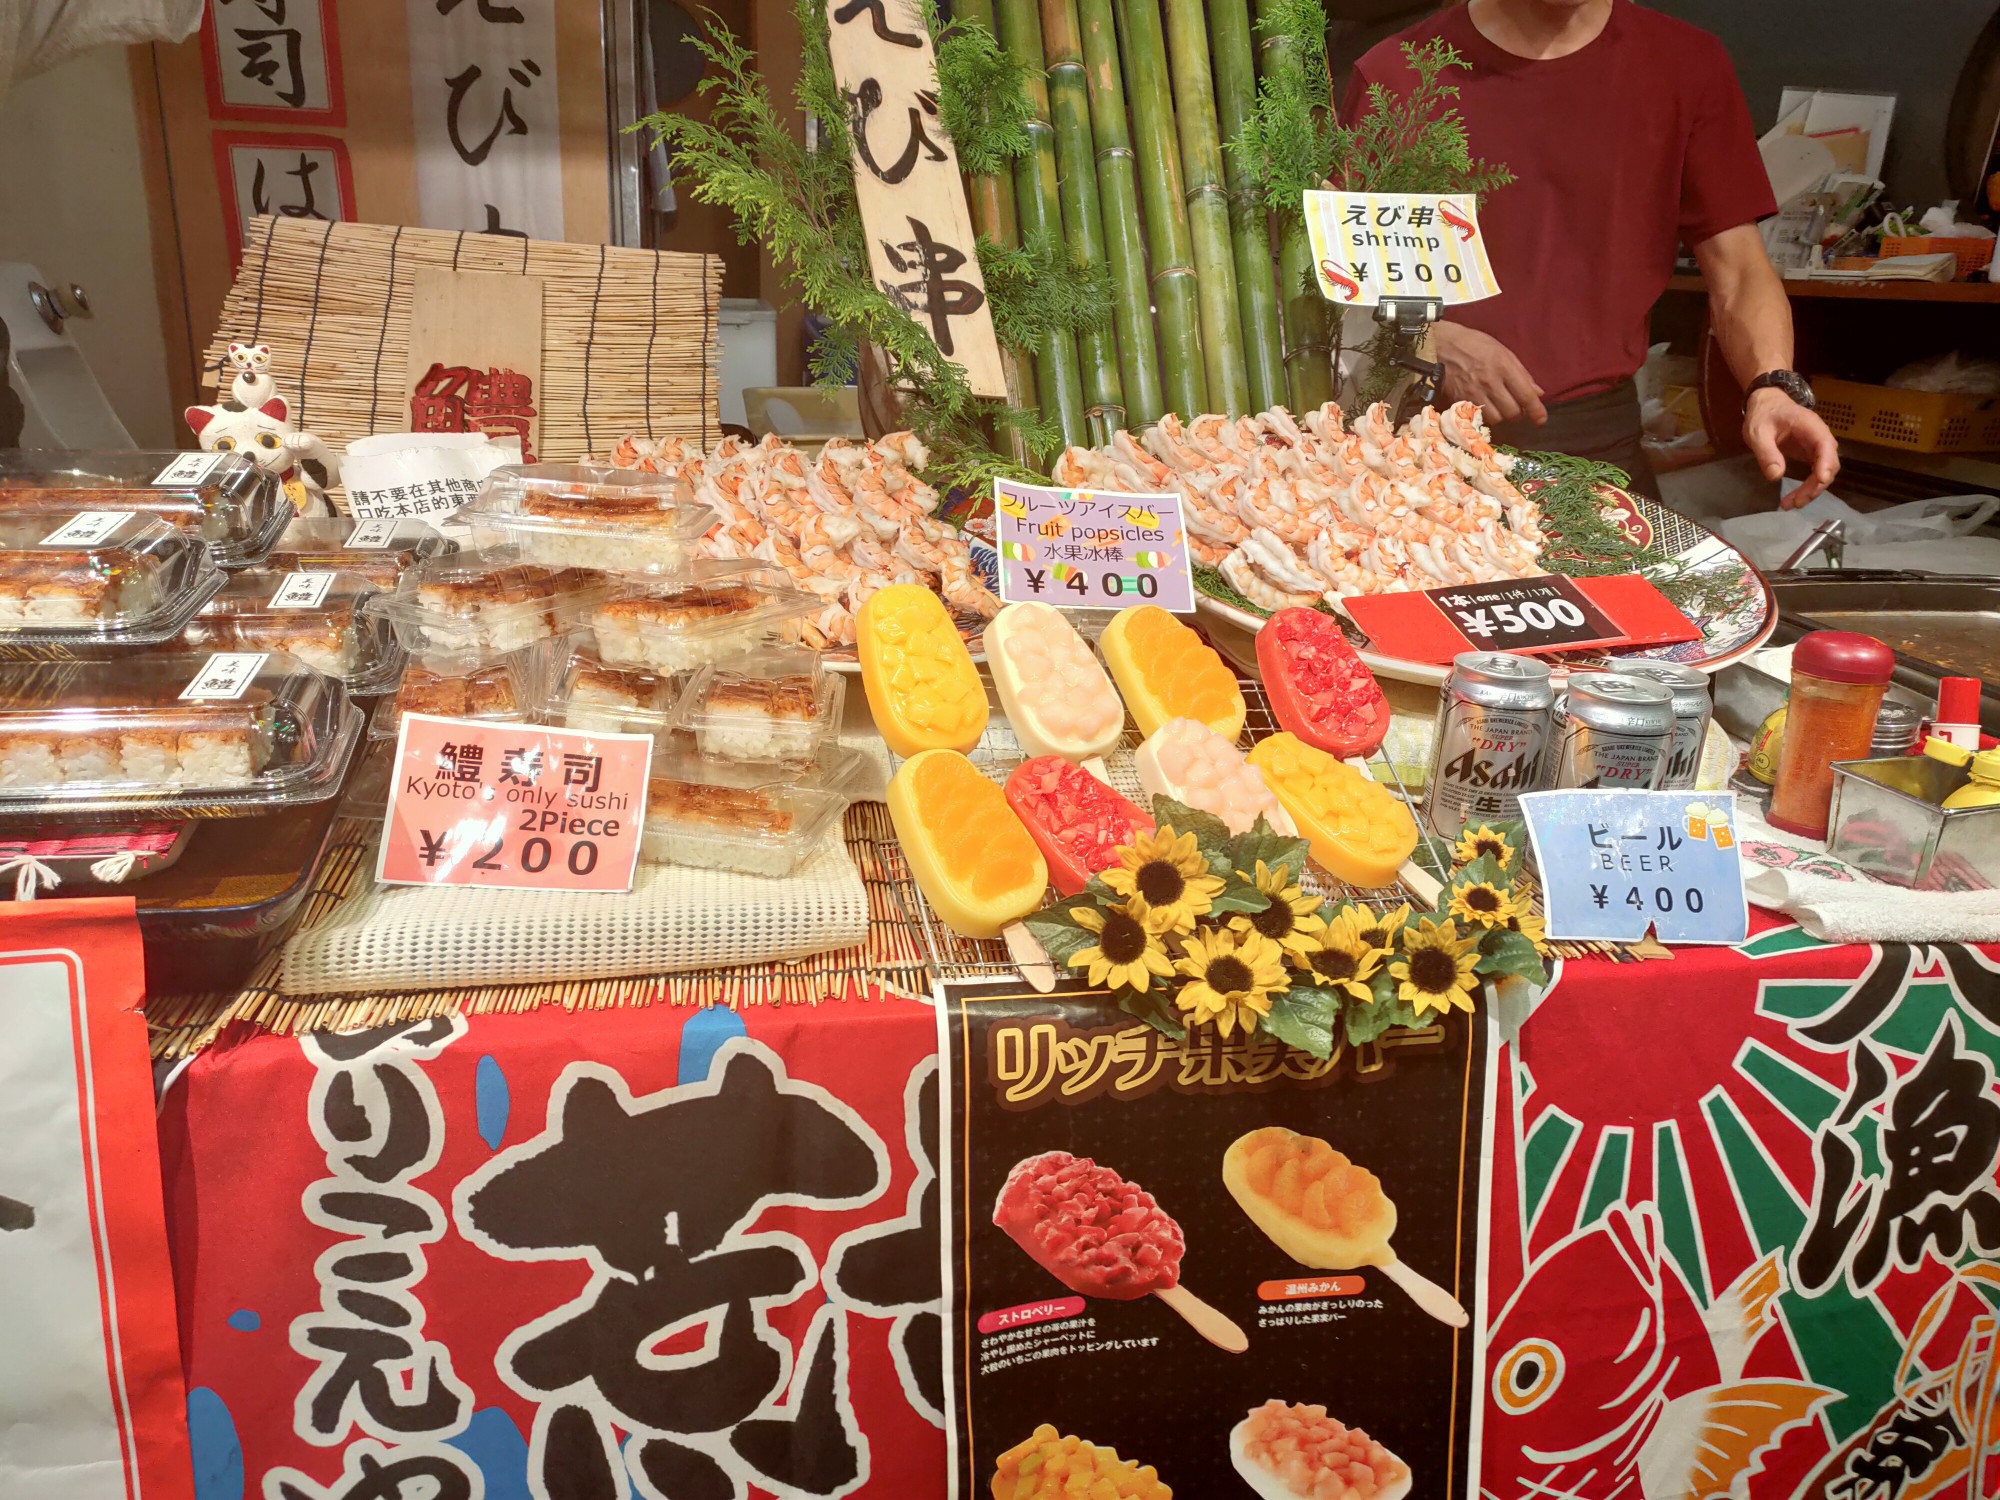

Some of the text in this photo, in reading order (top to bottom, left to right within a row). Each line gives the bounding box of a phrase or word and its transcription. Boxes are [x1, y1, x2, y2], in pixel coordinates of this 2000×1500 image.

[220, 0, 306, 107] 司
[1341, 204, 1434, 228] えび串
[1352, 231, 1440, 252] shrimp
[1350, 262, 1462, 283] ¥500
[1002, 491, 1174, 519] フルーツアイスバー
[1016, 517, 1165, 542] Fruit popsicles
[1043, 543, 1124, 563] 水果冰棒
[1024, 567, 1158, 599] ¥400
[1455, 598, 1585, 637] ¥500
[1469, 723, 1533, 736] THE JAPAN BRAND
[1490, 733, 1514, 741] SUPER
[1594, 750, 1659, 762] THE JAPAN BRAND
[1444, 747, 1541, 790] Asahi
[506, 786, 558, 809] only
[567, 792, 628, 810] sushi
[1475, 796, 1502, 813] 生
[519, 809, 620, 837] 2Piece
[1587, 823, 1683, 850] ビール
[418, 829, 599, 876] ¥200
[1600, 854, 1674, 873] BEER
[1590, 884, 1704, 914] ¥400
[998, 1304, 1066, 1326] ストロベリー
